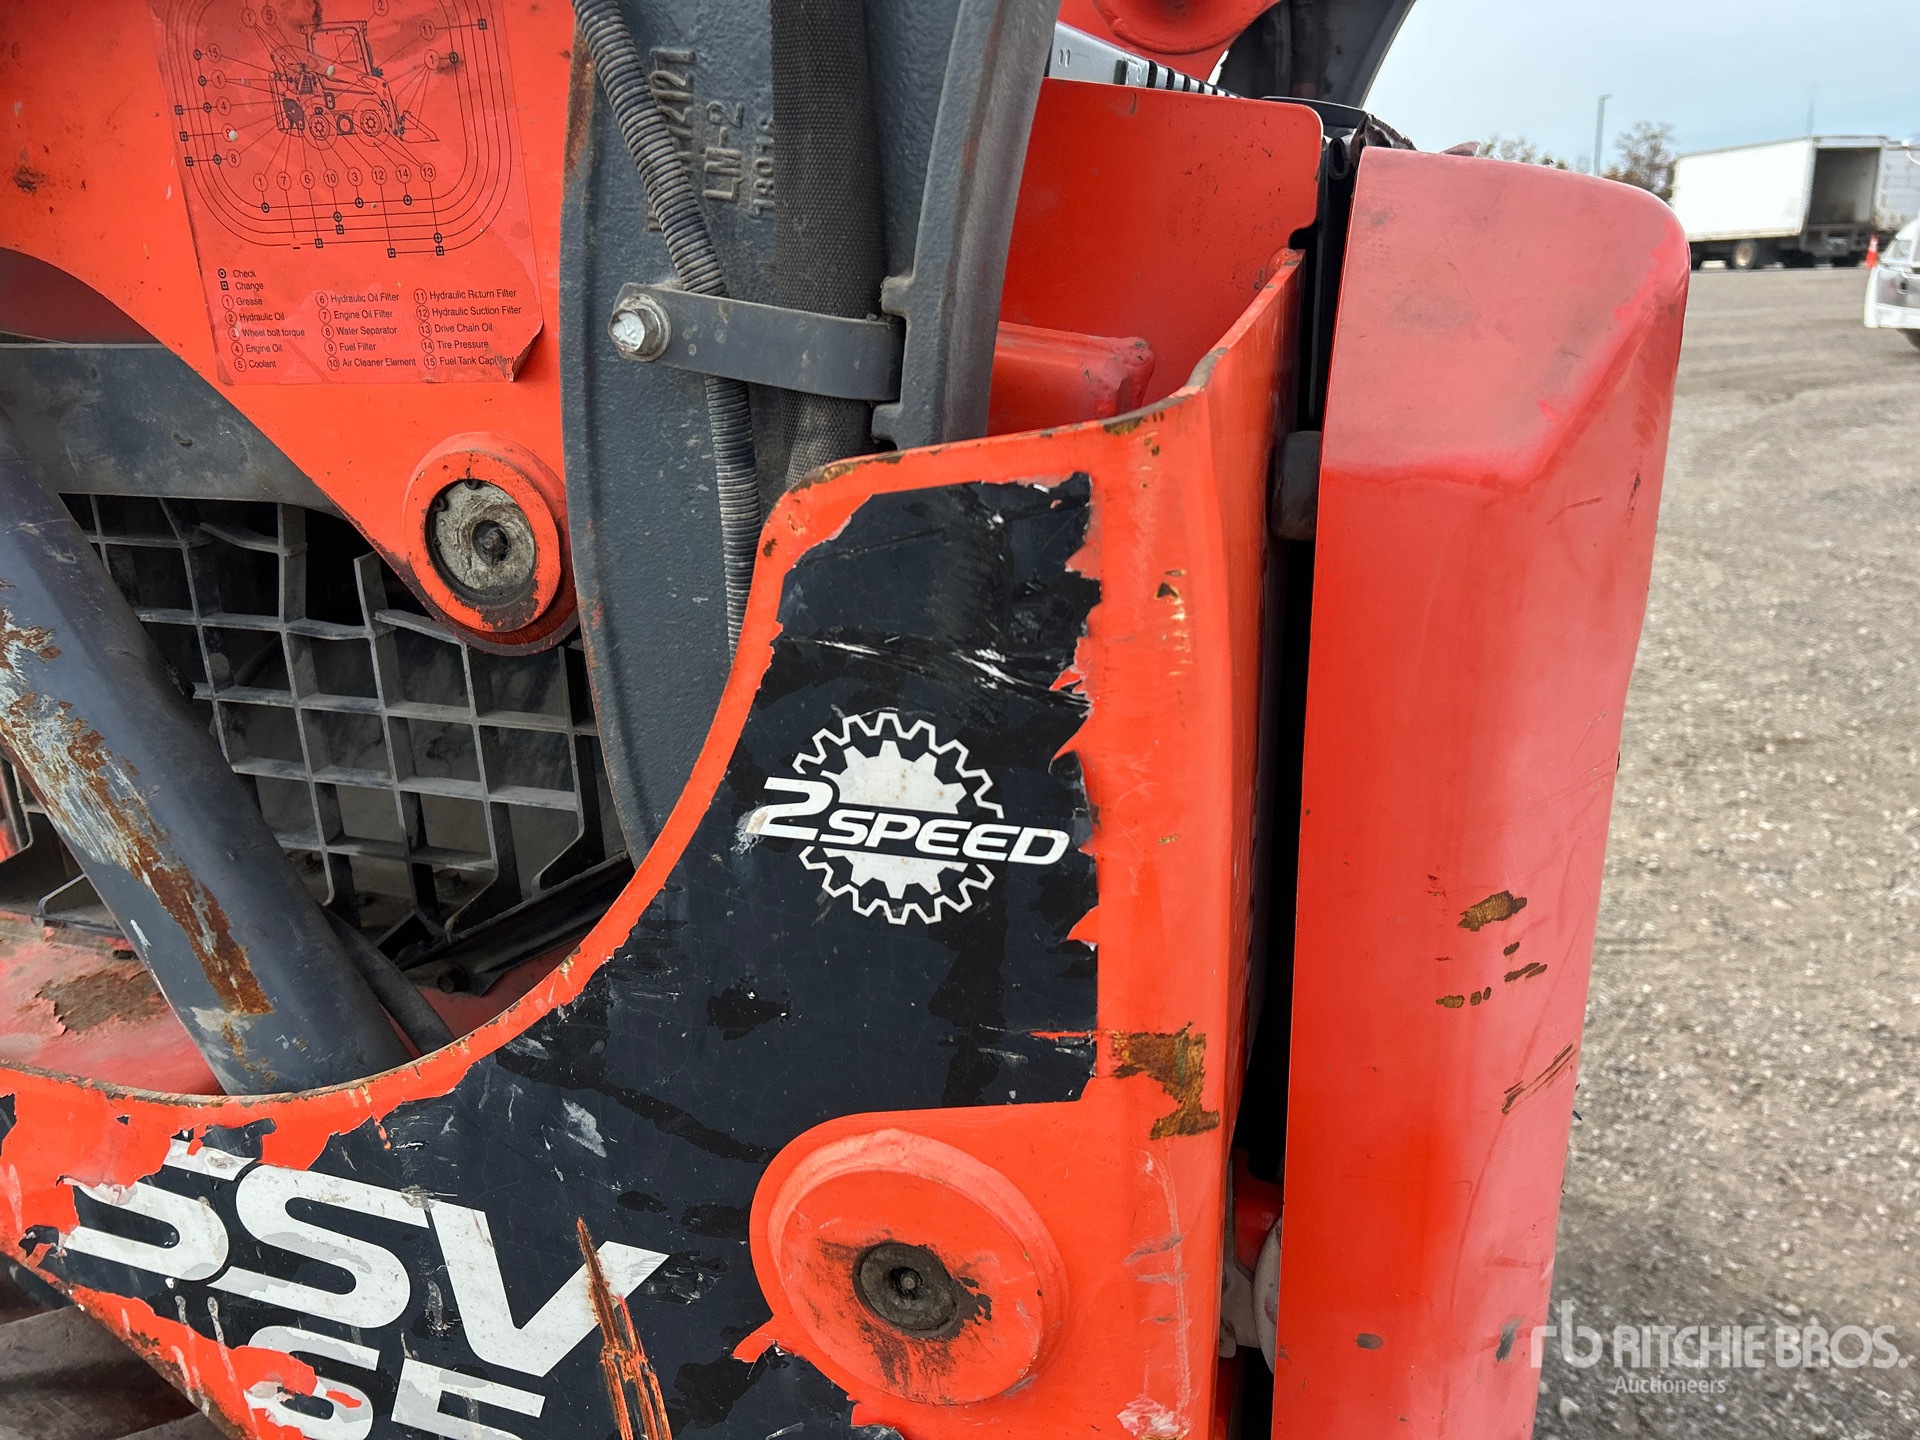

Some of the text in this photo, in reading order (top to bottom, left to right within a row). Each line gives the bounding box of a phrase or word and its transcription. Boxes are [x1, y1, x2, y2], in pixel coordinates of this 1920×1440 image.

[233, 269, 256, 278] Check
[235, 282, 263, 291] Change
[330, 295, 366, 304] Hydraulic
[367, 293, 378, 302] Oil
[380, 292, 399, 301] Filter
[429, 290, 466, 301] Hydraulic
[468, 289, 494, 299] Return
[497, 289, 516, 298] Filter
[236, 297, 263, 306] Grease
[239, 313, 273, 322] Hydraulic
[274, 312, 285, 320] Oil
[333, 311, 360, 321] Engine
[361, 310, 372, 318] Oil
[374, 309, 393, 318] Filter
[432, 307, 468, 318] Hydraulic
[470, 306, 499, 315] Suction
[501, 306, 521, 314] Filter
[336, 327, 358, 336] Water
[360, 326, 397, 336] Separator
[435, 324, 454, 333] Drive
[456, 323, 480, 332] Chain
[481, 323, 493, 331] Oil
[242, 329, 266, 337] Wheel
[281, 329, 305, 339] torque
[246, 345, 270, 354] Engine
[272, 344, 282, 352] Oil
[339, 343, 355, 351] Fuel
[358, 342, 376, 351] Filter
[437, 340, 452, 349] Tire
[454, 340, 489, 349] Pressure
[249, 360, 276, 368] Coolant
[342, 359, 352, 367] Air
[354, 358, 383, 367] Cleaner
[385, 358, 416, 366] Element
[439, 357, 456, 365] Fuel
[457, 356, 476, 365] Tank
[819, 809, 1070, 865] SPEED
